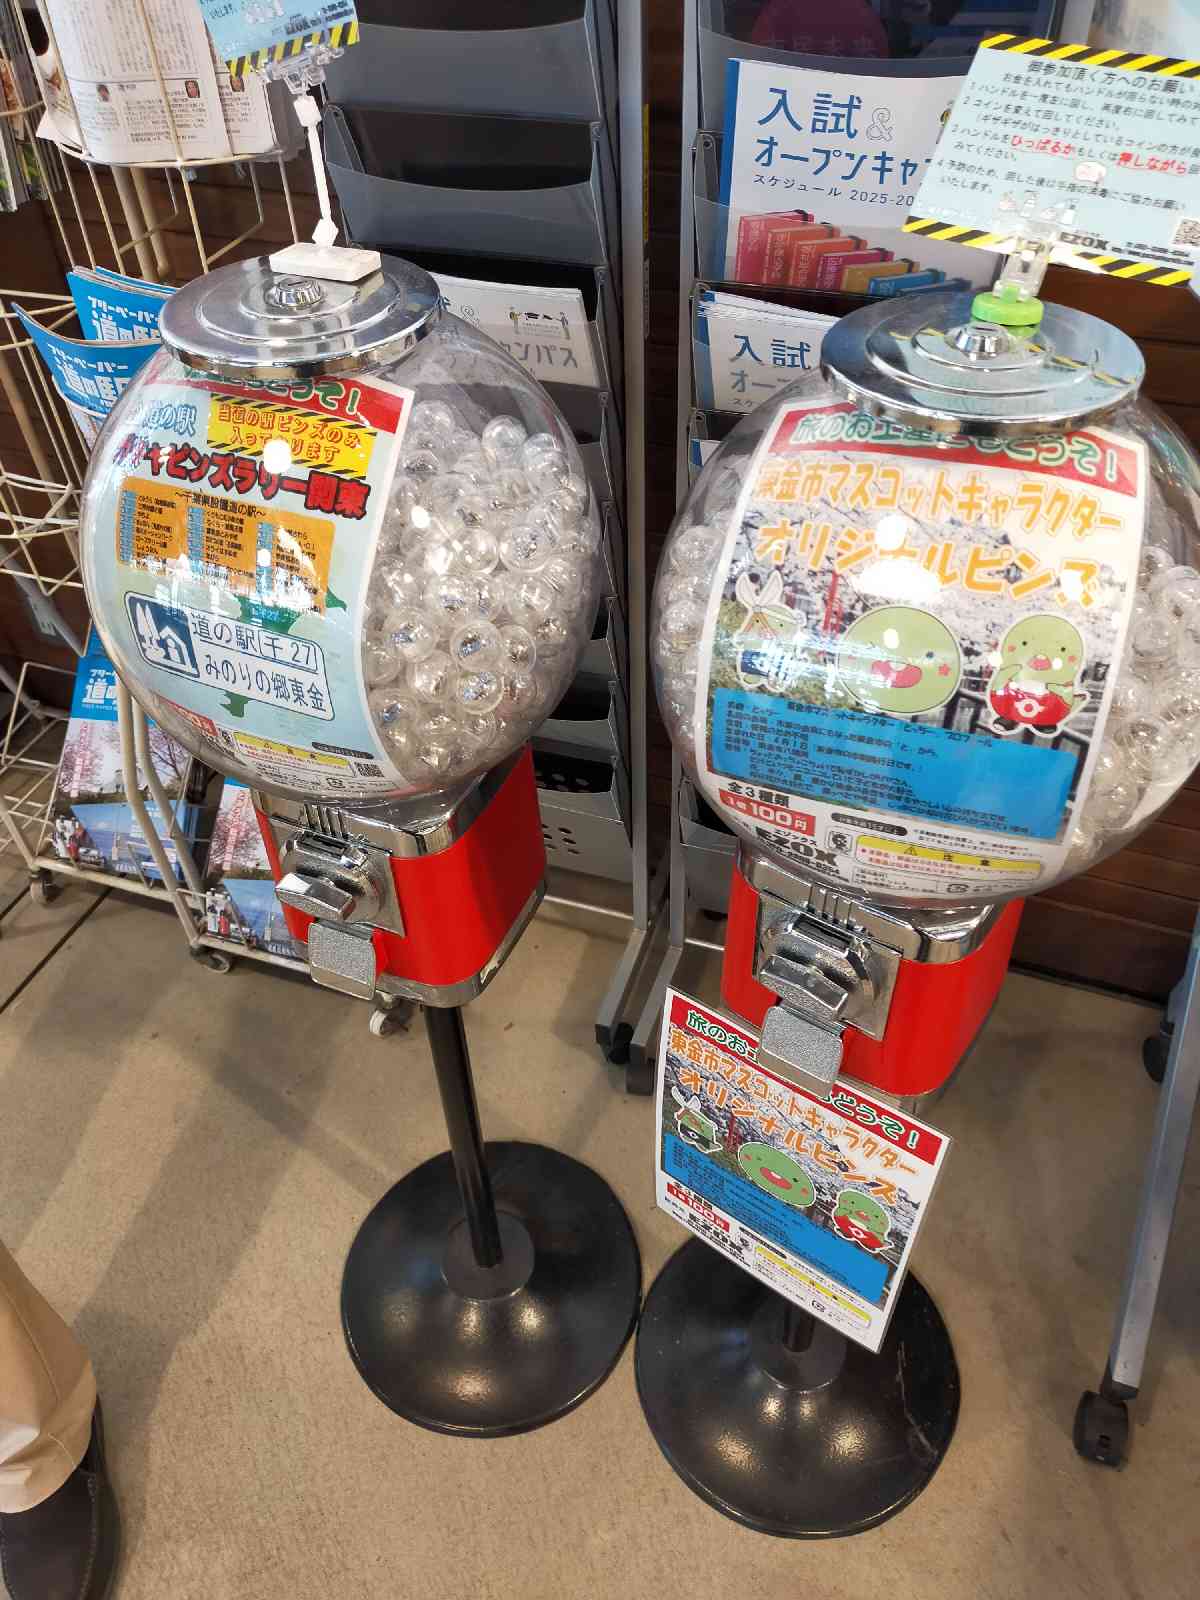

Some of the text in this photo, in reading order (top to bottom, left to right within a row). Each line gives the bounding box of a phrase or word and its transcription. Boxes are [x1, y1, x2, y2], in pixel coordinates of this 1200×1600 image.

[757, 86, 862, 140] 入試
[754, 135, 932, 186] オープンキャ
[730, 334, 813, 370] 入試
[192, 617, 258, 653] 道の駅
[289, 638, 312, 666] 27
[204, 652, 329, 714] みのりの郷東金
[669, 1027, 919, 1176] 東金市マスコットキャラクター
[679, 1067, 897, 1206] オリジナルピンズ
